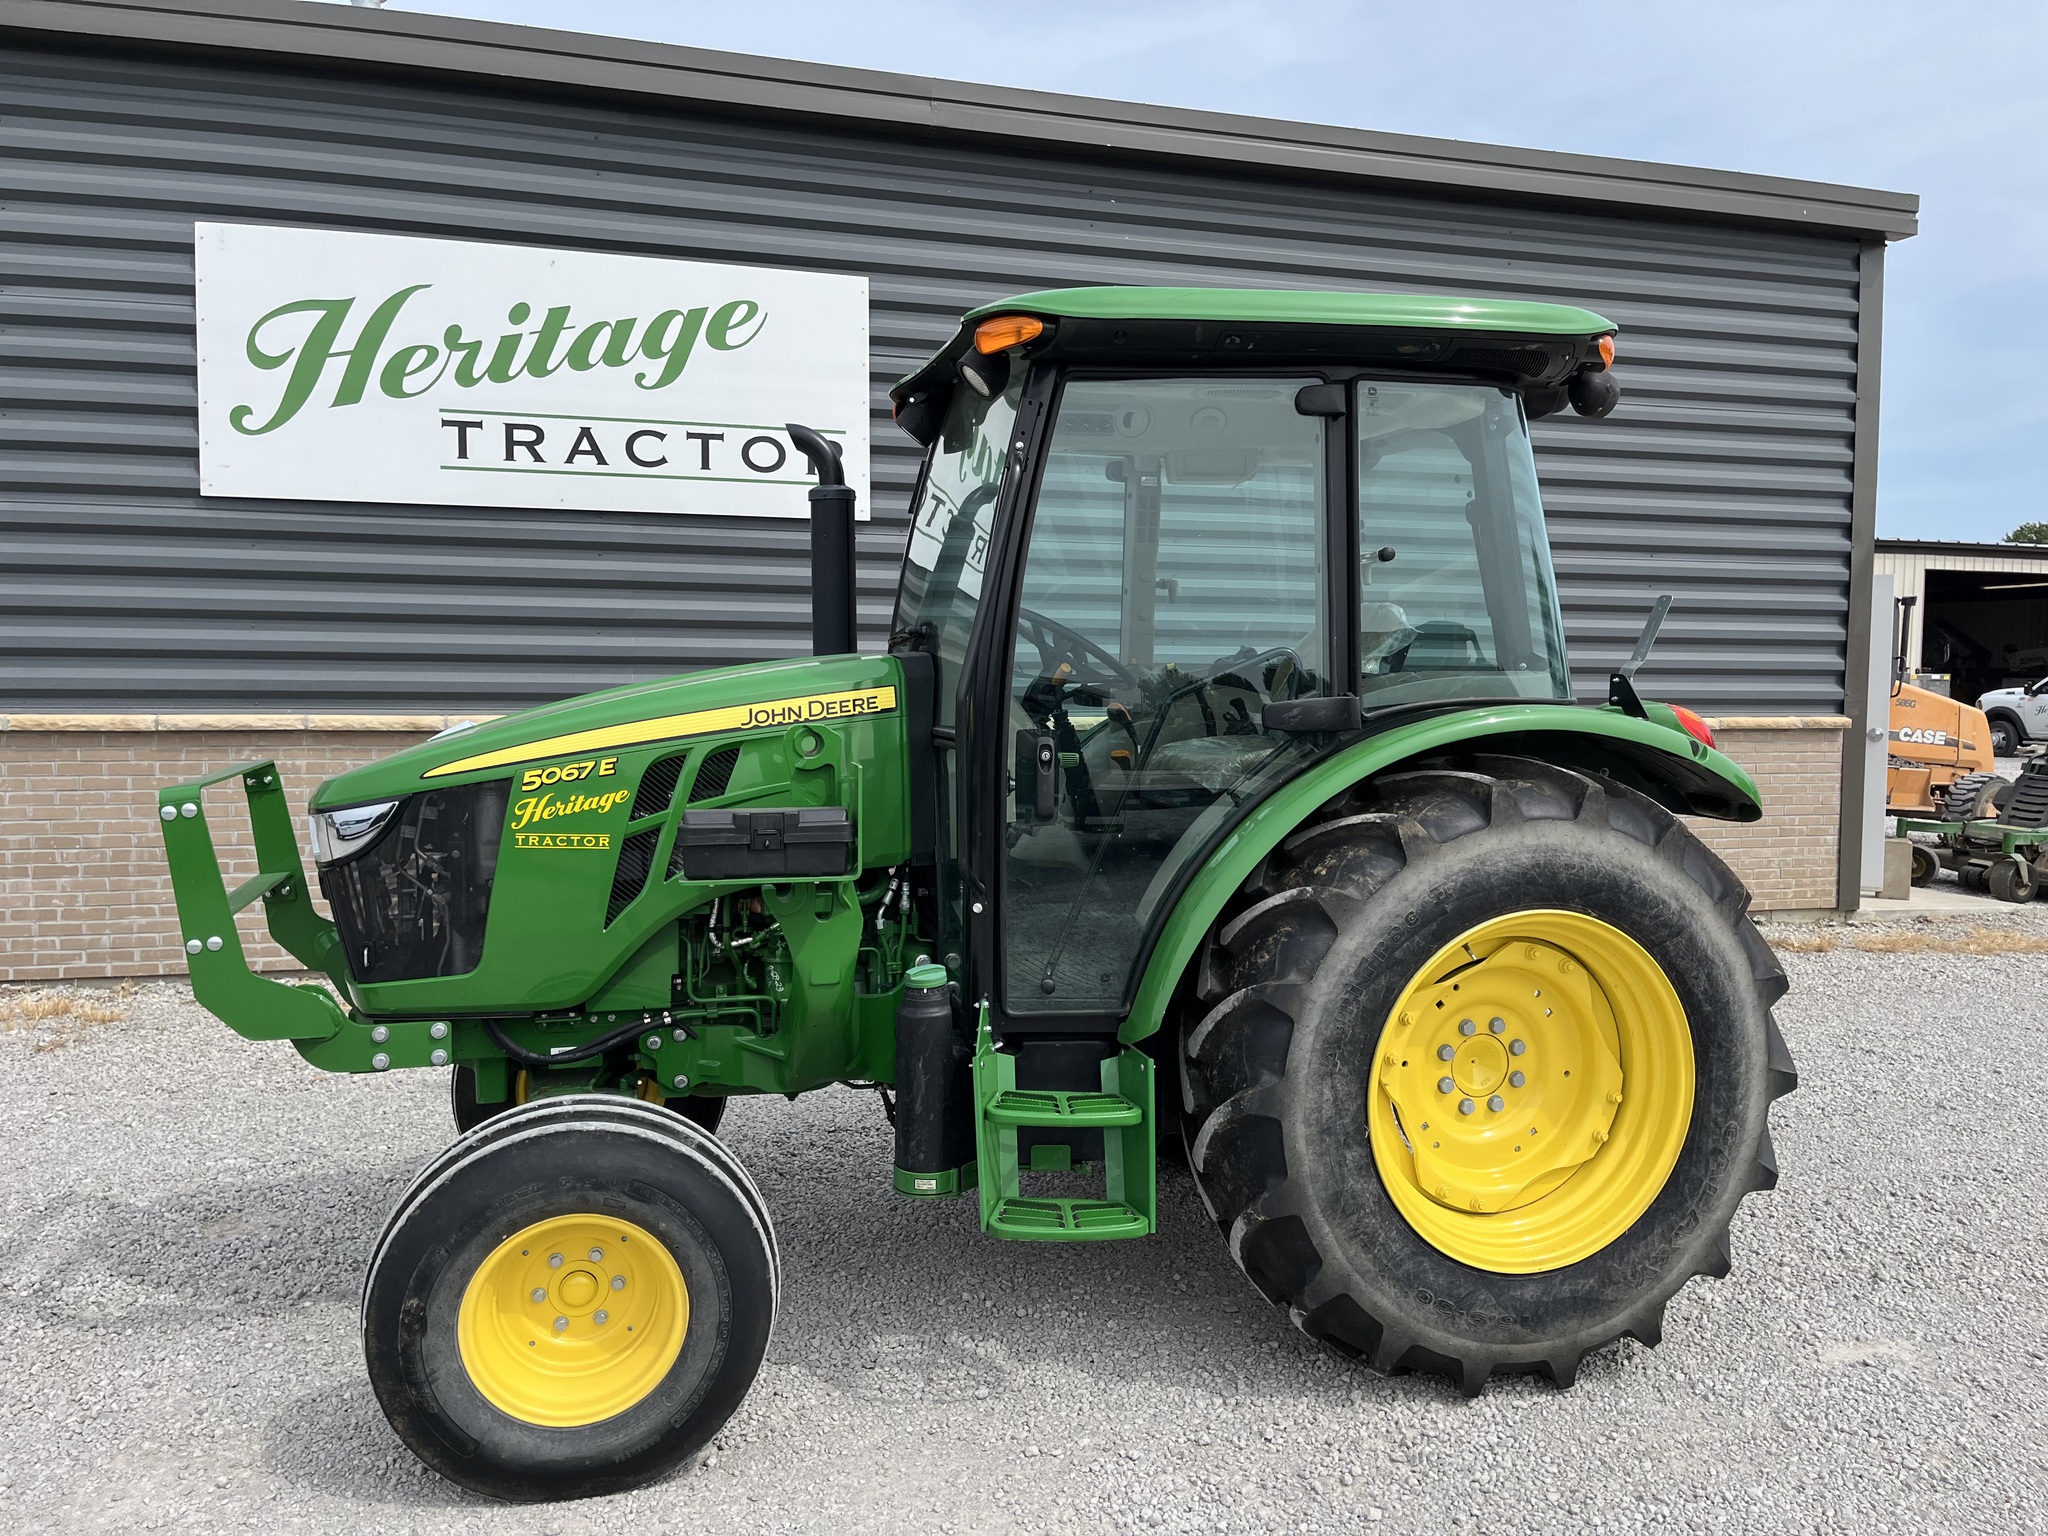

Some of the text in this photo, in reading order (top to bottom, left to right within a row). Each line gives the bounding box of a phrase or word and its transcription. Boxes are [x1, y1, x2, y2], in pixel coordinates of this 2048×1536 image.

[229, 284, 768, 435] Heritage
[740, 695, 880, 727] JOHN DEERE
[1898, 727, 1948, 745] CASE
[521, 757, 618, 792] 5067 E
[511, 789, 631, 830] Heritage
[515, 835, 610, 847] TRACTOR
